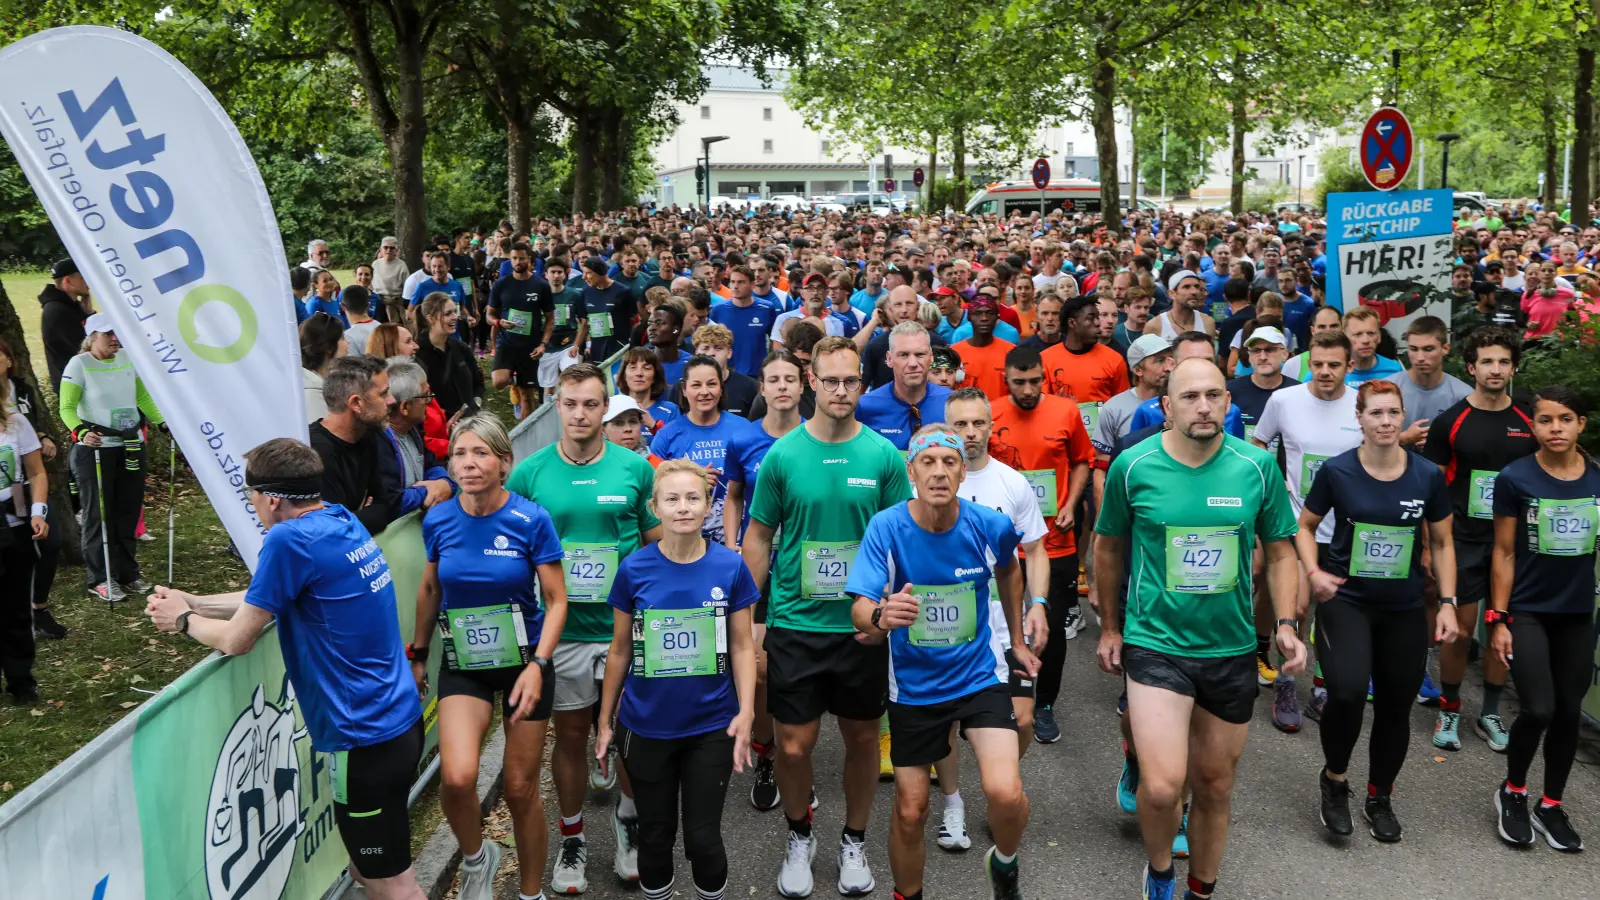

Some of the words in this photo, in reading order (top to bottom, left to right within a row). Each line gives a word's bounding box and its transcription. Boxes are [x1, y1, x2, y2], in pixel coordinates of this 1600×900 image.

[1341, 198, 1433, 222] RÜCKGABE
[1342, 216, 1420, 238] ZEITCHIP
[1346, 244, 1425, 276] HIER!
[696, 440, 722, 448] STADT
[684, 448, 727, 460] AMBER
[0, 460, 8, 473] 6
[1480, 486, 1493, 499] 12
[1549, 518, 1592, 534] 1824
[484, 548, 518, 557] GRAMMER
[1364, 542, 1403, 558] 1627
[1182, 550, 1222, 567] 427
[570, 563, 605, 578] 422
[818, 562, 847, 577] 421
[955, 567, 984, 577] CONRAD
[926, 606, 959, 622] 310
[466, 627, 500, 645] 857
[663, 631, 696, 650] 801
[360, 847, 383, 855] GORE
